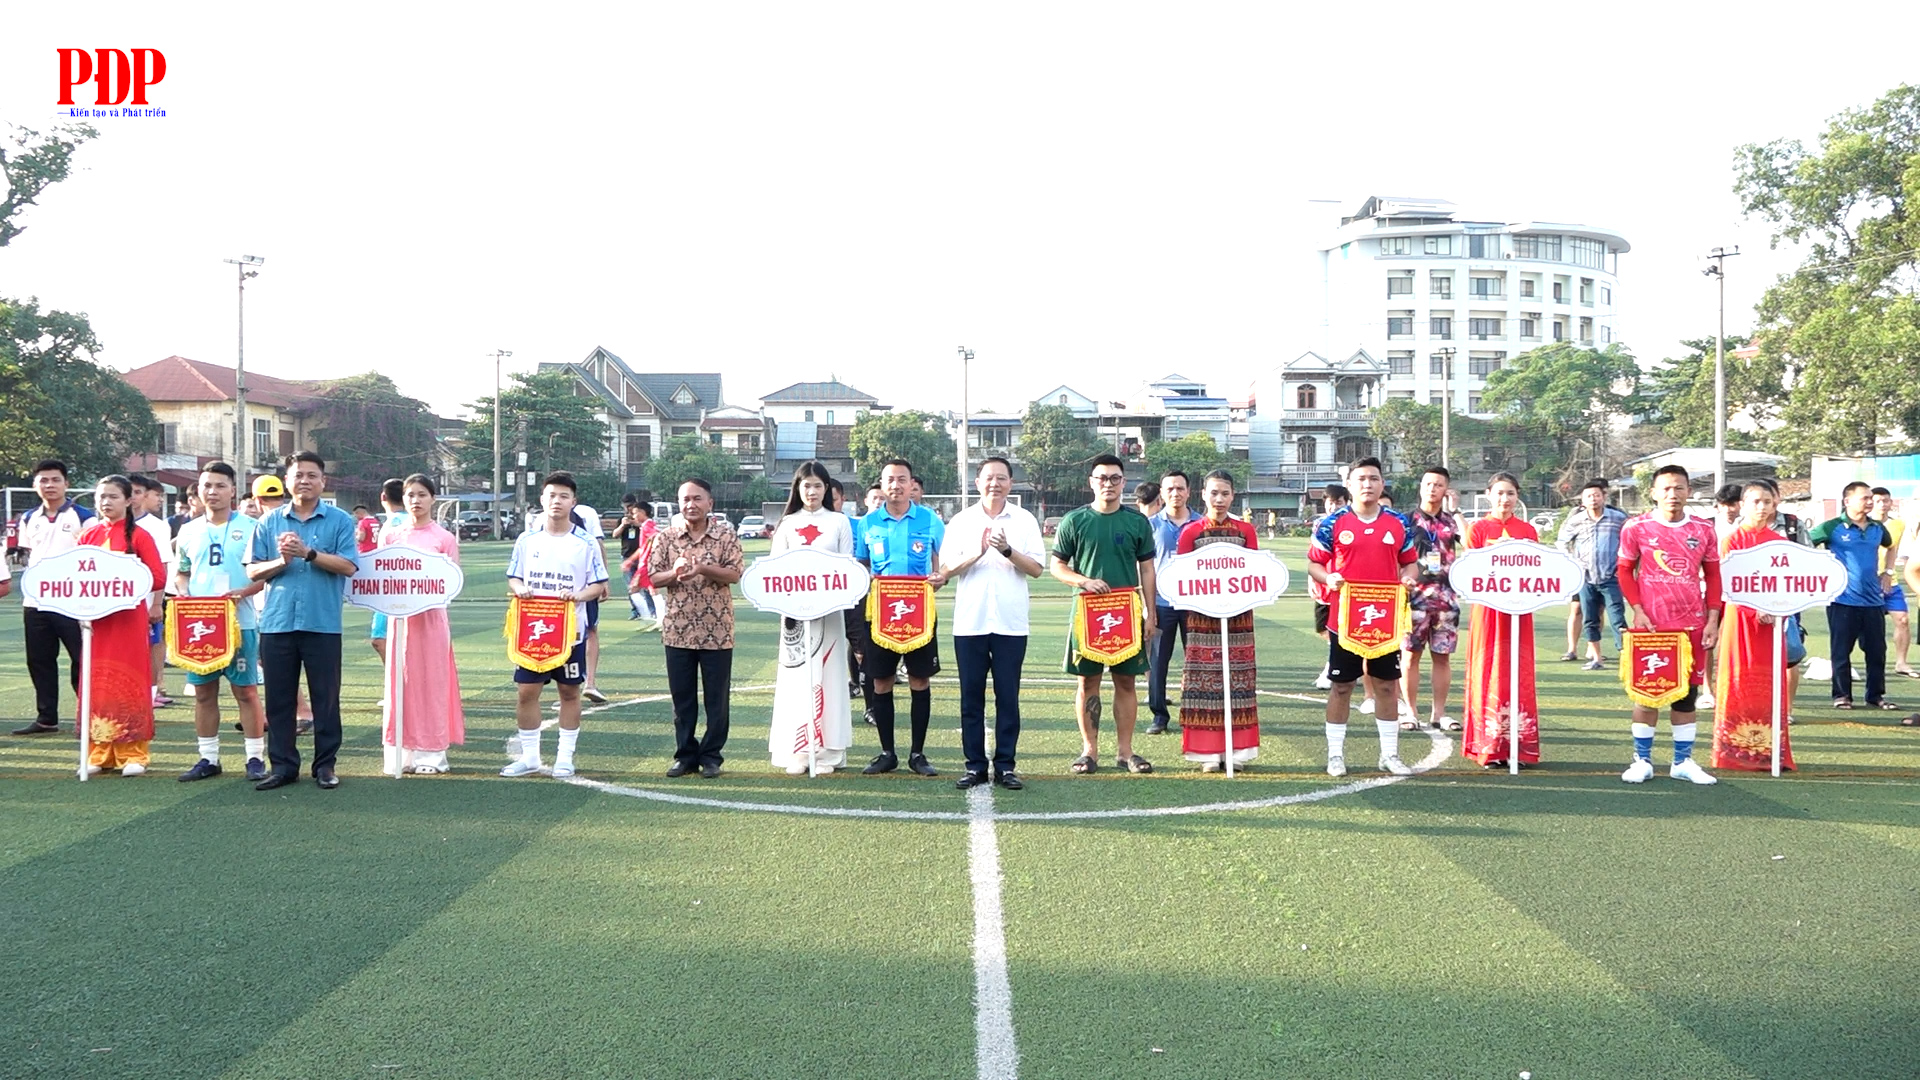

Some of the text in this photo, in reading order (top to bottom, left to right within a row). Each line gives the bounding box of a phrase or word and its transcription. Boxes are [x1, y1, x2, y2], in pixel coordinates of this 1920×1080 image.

[78, 558, 96, 572] XÃ
[209, 543, 222, 567] 6
[375, 557, 422, 571] PHƯỜNG
[1197, 555, 1246, 570] PHƯỜNG
[1491, 553, 1541, 567] PHƯỜNG
[1770, 553, 1790, 567] XÃ
[40, 577, 134, 597] PHÚ XUYÊN
[352, 575, 445, 595] PHAN ĐÌNH PHÙNG
[763, 570, 848, 596] TRỌNG TÀI
[1178, 575, 1267, 596] LINH SƠN
[1472, 571, 1561, 597] BẮC KẠN
[1731, 570, 1829, 596] ĐIỂM THỤY
[563, 662, 580, 679] 19
